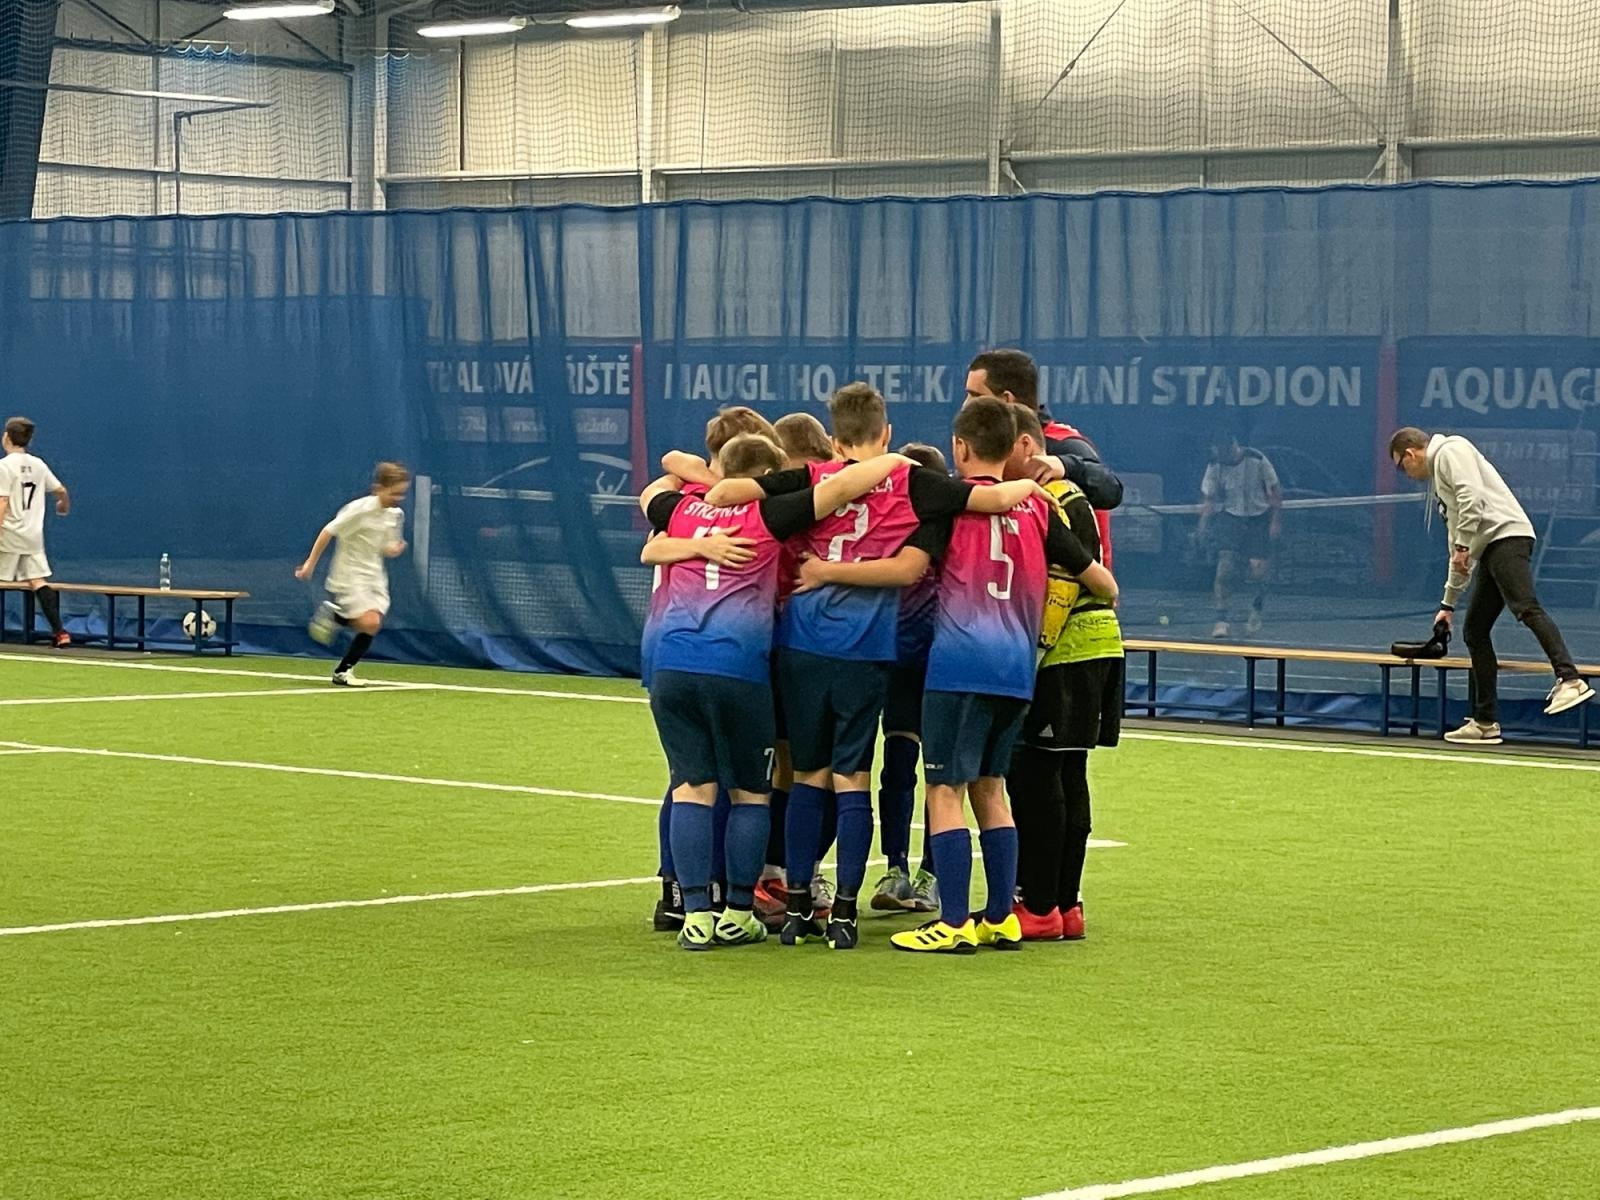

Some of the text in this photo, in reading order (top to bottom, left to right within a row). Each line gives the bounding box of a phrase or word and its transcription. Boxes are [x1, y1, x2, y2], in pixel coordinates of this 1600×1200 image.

[1038, 356, 1361, 406] IMNÍ STADION
[1420, 366, 1600, 414] AQUAC
[21, 481, 36, 511] 17
[987, 515, 1019, 600] 5
[764, 747, 775, 781] 7
